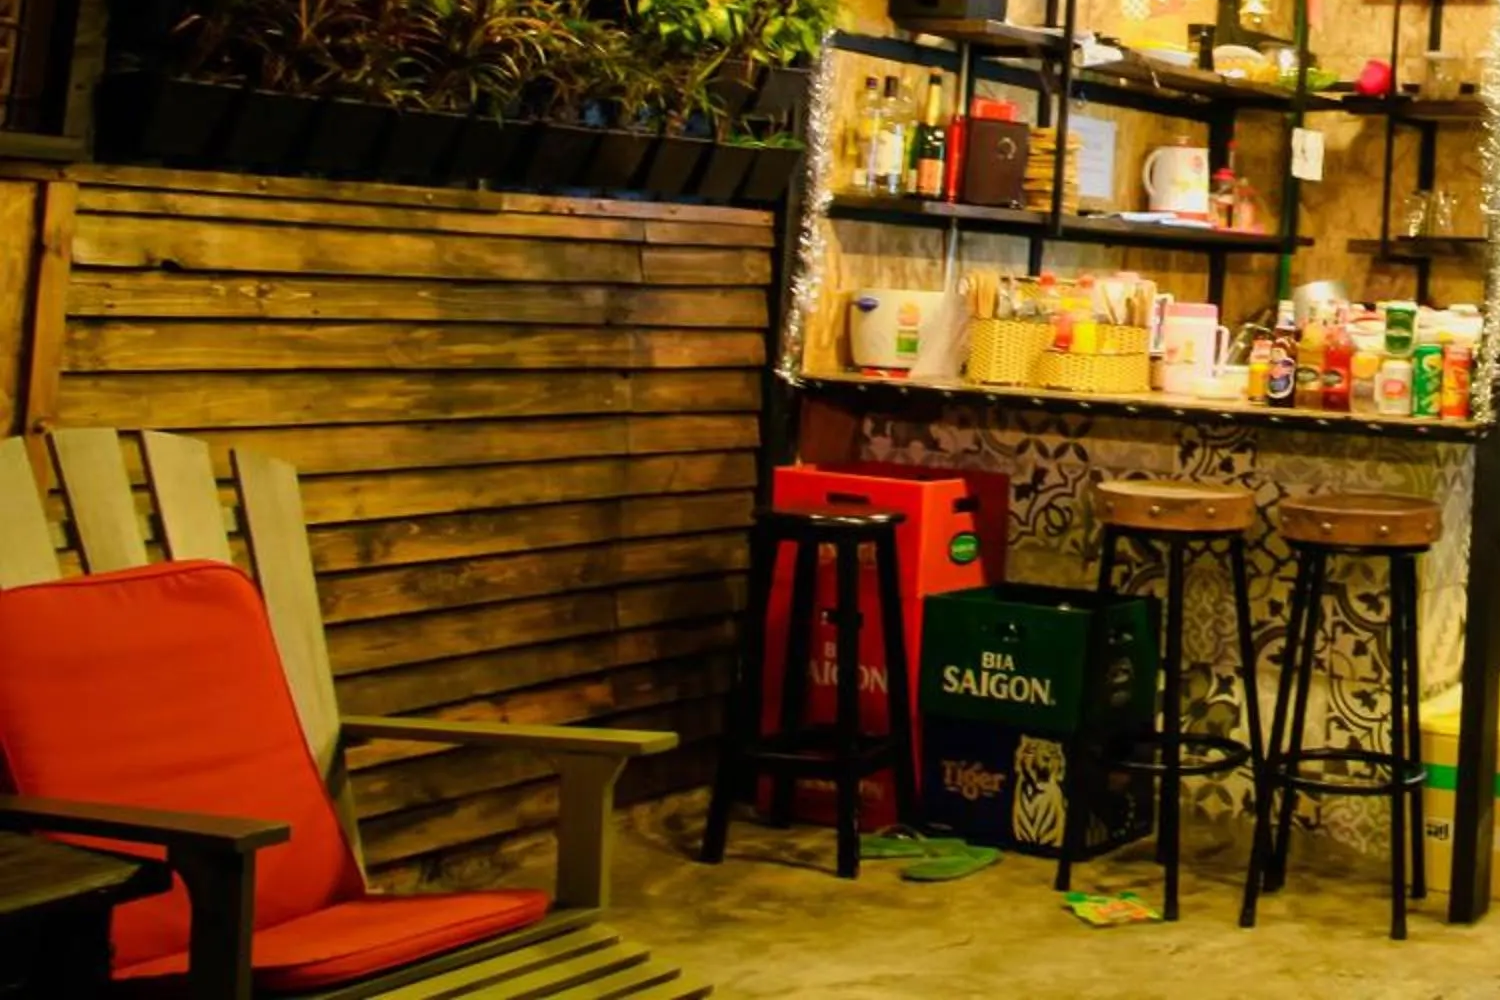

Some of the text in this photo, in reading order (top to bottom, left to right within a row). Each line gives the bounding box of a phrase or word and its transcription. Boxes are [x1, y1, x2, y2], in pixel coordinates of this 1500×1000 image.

[981, 650, 1016, 672] BIA
[942, 664, 1053, 706] SAIGON
[941, 759, 1006, 800] Tiger
